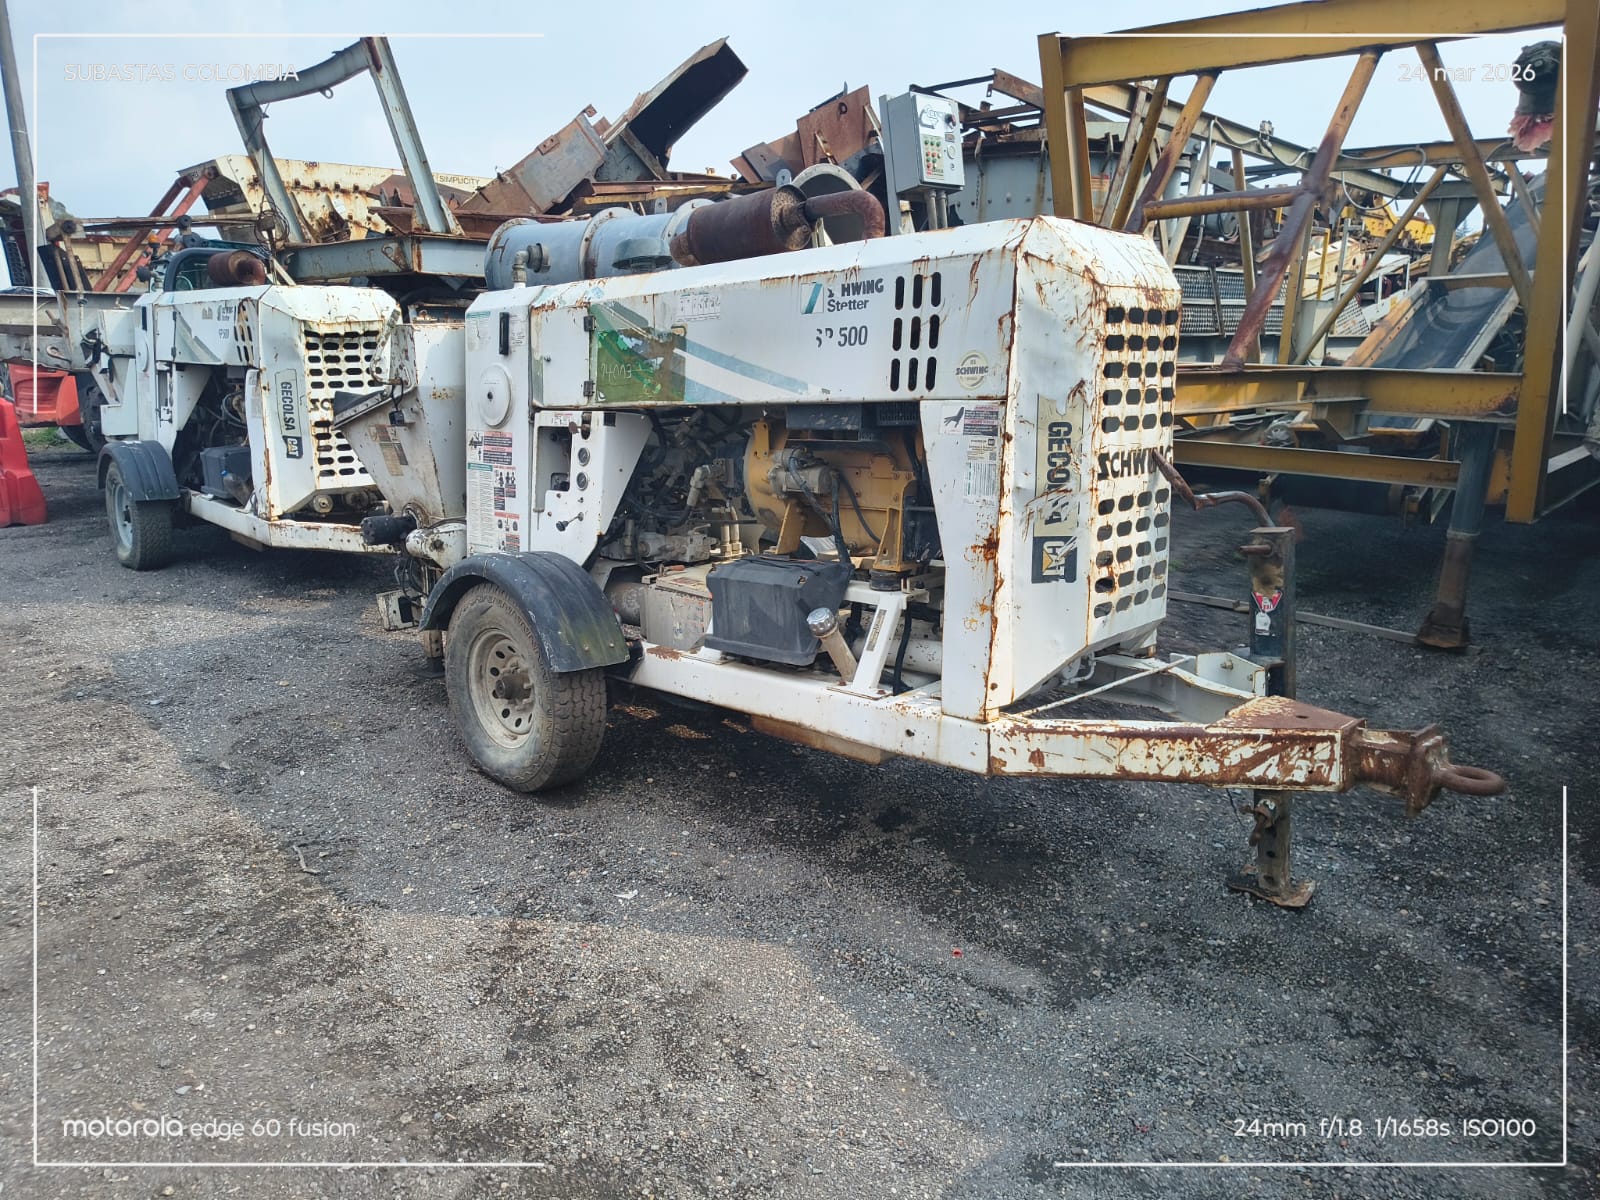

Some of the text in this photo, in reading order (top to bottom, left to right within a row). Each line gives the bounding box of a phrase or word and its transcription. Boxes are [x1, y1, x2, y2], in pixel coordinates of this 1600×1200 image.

[827, 278, 884, 298] HWING
[838, 325, 868, 347] 500
[280, 381, 297, 431] GECOLSA
